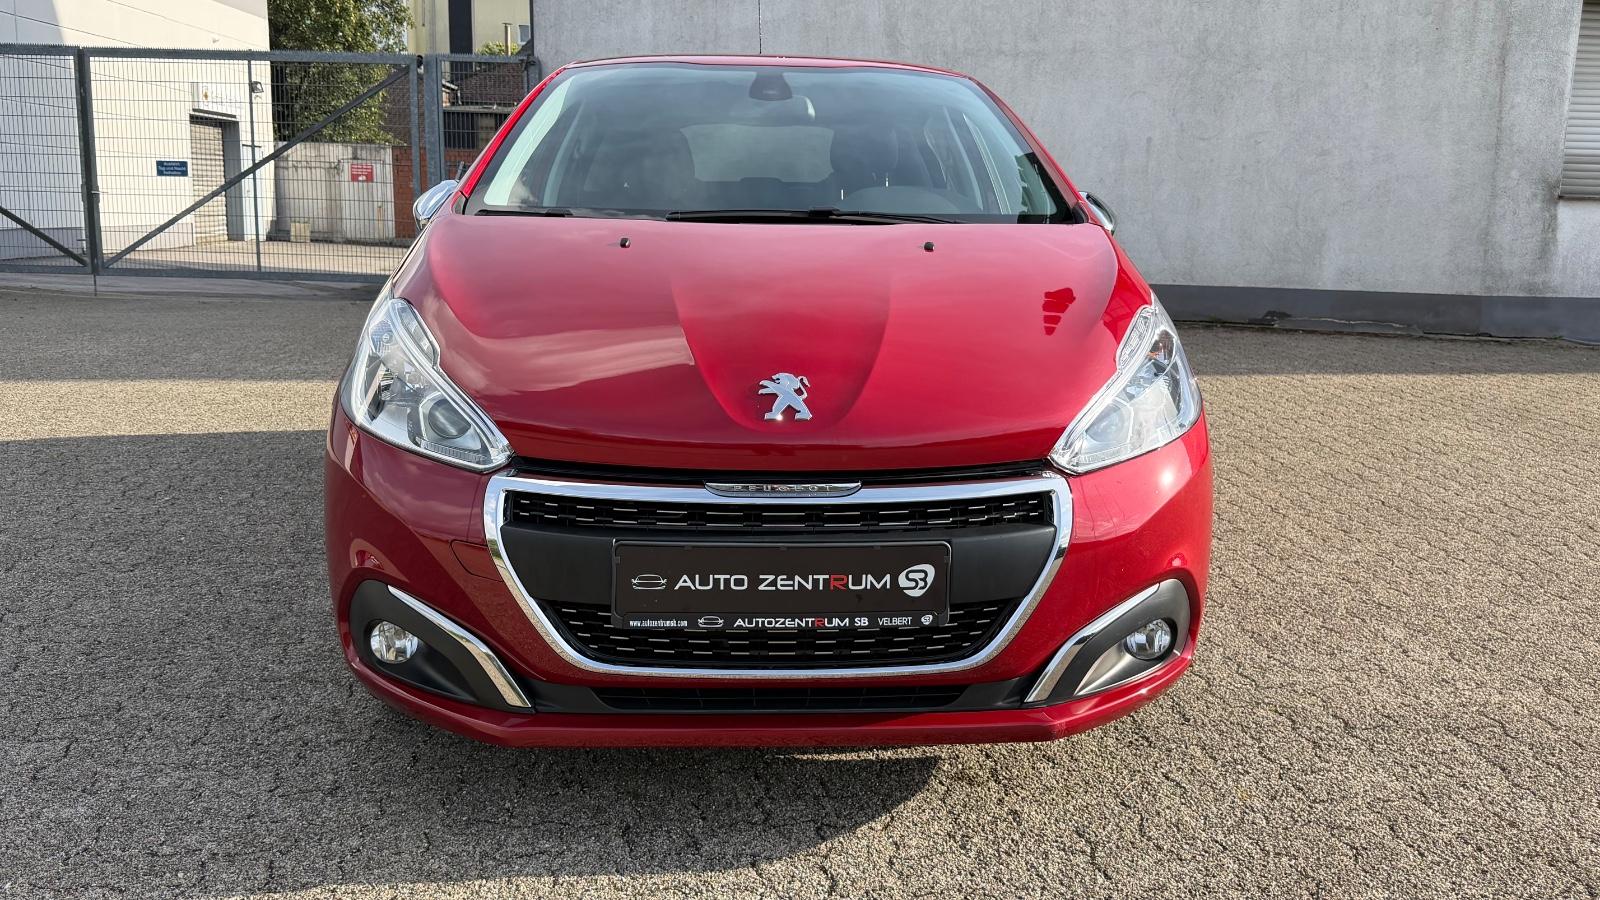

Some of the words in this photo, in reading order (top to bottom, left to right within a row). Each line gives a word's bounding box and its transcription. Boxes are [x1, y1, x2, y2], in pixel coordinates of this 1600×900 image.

[674, 574, 749, 590] AUTO
[757, 574, 891, 591] ZENTRUM
[629, 618, 688, 627] www.autozentrumsb.com
[733, 617, 850, 628] AUTOZENTRUM
[854, 617, 869, 626] SB
[877, 616, 913, 626] VELBERT
